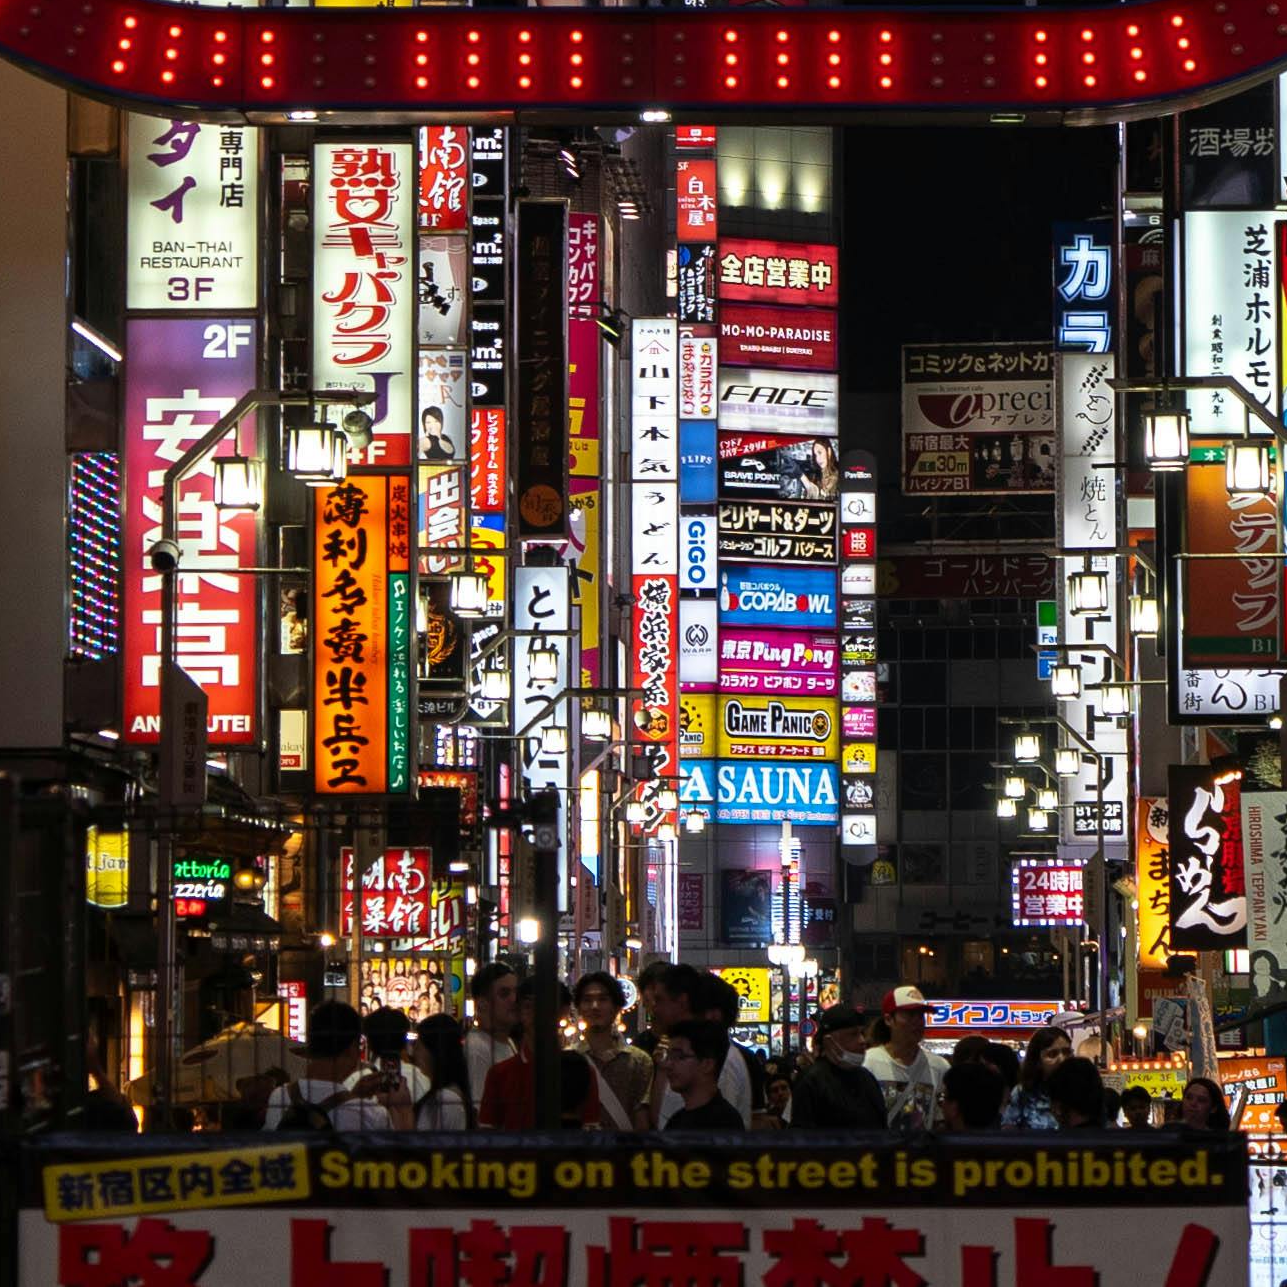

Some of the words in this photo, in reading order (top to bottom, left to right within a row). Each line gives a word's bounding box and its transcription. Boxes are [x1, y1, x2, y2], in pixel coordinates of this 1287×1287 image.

[146, 121, 201, 224] タイ
[687, 176, 715, 227] 白木屋
[140, 256, 244, 269] RESTAURANT
[151, 241, 234, 255] BAN-THAI
[321, 147, 408, 367] 熟女キャバクラ
[579, 219, 598, 321] キャバクラ
[720, 254, 832, 291] 全店営業中
[166, 277, 215, 302] 3F
[694, 256, 706, 321] インターネット
[1058, 234, 1113, 353] カラ
[202, 325, 251, 360] 2F
[721, 324, 831, 342] MO-MO-PARADISE
[699, 354, 713, 405] カラオケ
[1211, 314, 1224, 418] 創業昭和二九年
[721, 385, 834, 408] FACE
[344, 440, 387, 465] 4F
[486, 411, 499, 470] レンタルルーム
[910, 435, 970, 452] 新宿最大
[638, 364, 672, 566] 山下本気うどん
[755, 472, 781, 482] POINT
[486, 473, 499, 506] ホステル
[909, 477, 970, 490] ハイジアB1
[389, 484, 409, 561] 炭火串焼
[428, 469, 460, 574] 出会い
[718, 505, 834, 535] ビリヤード&ダーツ
[1080, 476, 1108, 541] 焼とん
[141, 388, 241, 688] 安楽亭
[754, 538, 792, 558] ゴルフ
[794, 541, 834, 559] バグース
[851, 532, 867, 541] MO
[851, 541, 867, 550] MO
[637, 578, 673, 709] 横浜家系
[721, 639, 752, 660] 東京
[752, 640, 789, 669] Ping
[1251, 639, 1273, 653] B1
[720, 675, 759, 687] カラオケ
[807, 678, 835, 690] ダーツ
[726, 702, 767, 733] GAME
[770, 704, 812, 735] PANIC
[1253, 694, 1276, 711] B1
[130, 715, 251, 732] ANUTEI
[731, 745, 756, 755] プライズ
[779, 746, 810, 756] アーケード
[717, 766, 838, 804] SAUNA
[1248, 805, 1262, 866] HIROSHIMA
[345, 852, 426, 892] 湖南
[1024, 870, 1083, 891] 24時間
[1024, 894, 1083, 916] 営業中
[1251, 871, 1267, 942] TEPPANYAKI
[55, 1153, 298, 1211] 新宿区内全域
[319, 1150, 536, 1199] Smoking
[553, 1157, 614, 1189] on
[629, 1153, 710, 1188] the
[726, 1152, 880, 1189] street
[894, 1152, 937, 1188] is
[952, 1150, 1225, 1197] prohibited.
